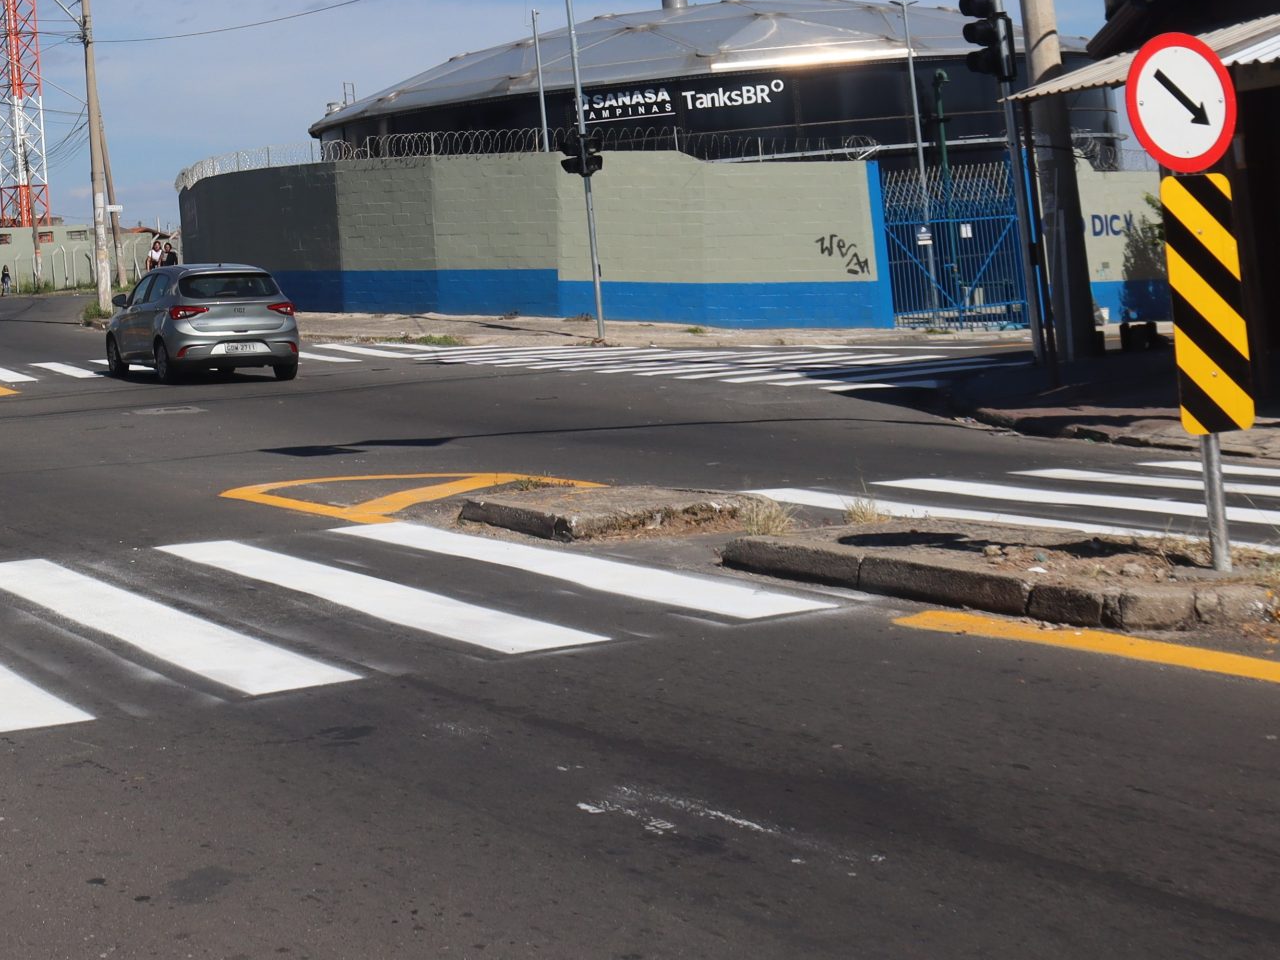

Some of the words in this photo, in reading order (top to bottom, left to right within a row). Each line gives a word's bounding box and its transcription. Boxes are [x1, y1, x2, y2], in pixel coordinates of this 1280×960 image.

[592, 87, 671, 109] SANASA
[576, 102, 673, 120] AMPINAS
[1091, 214, 1121, 237] DIC
